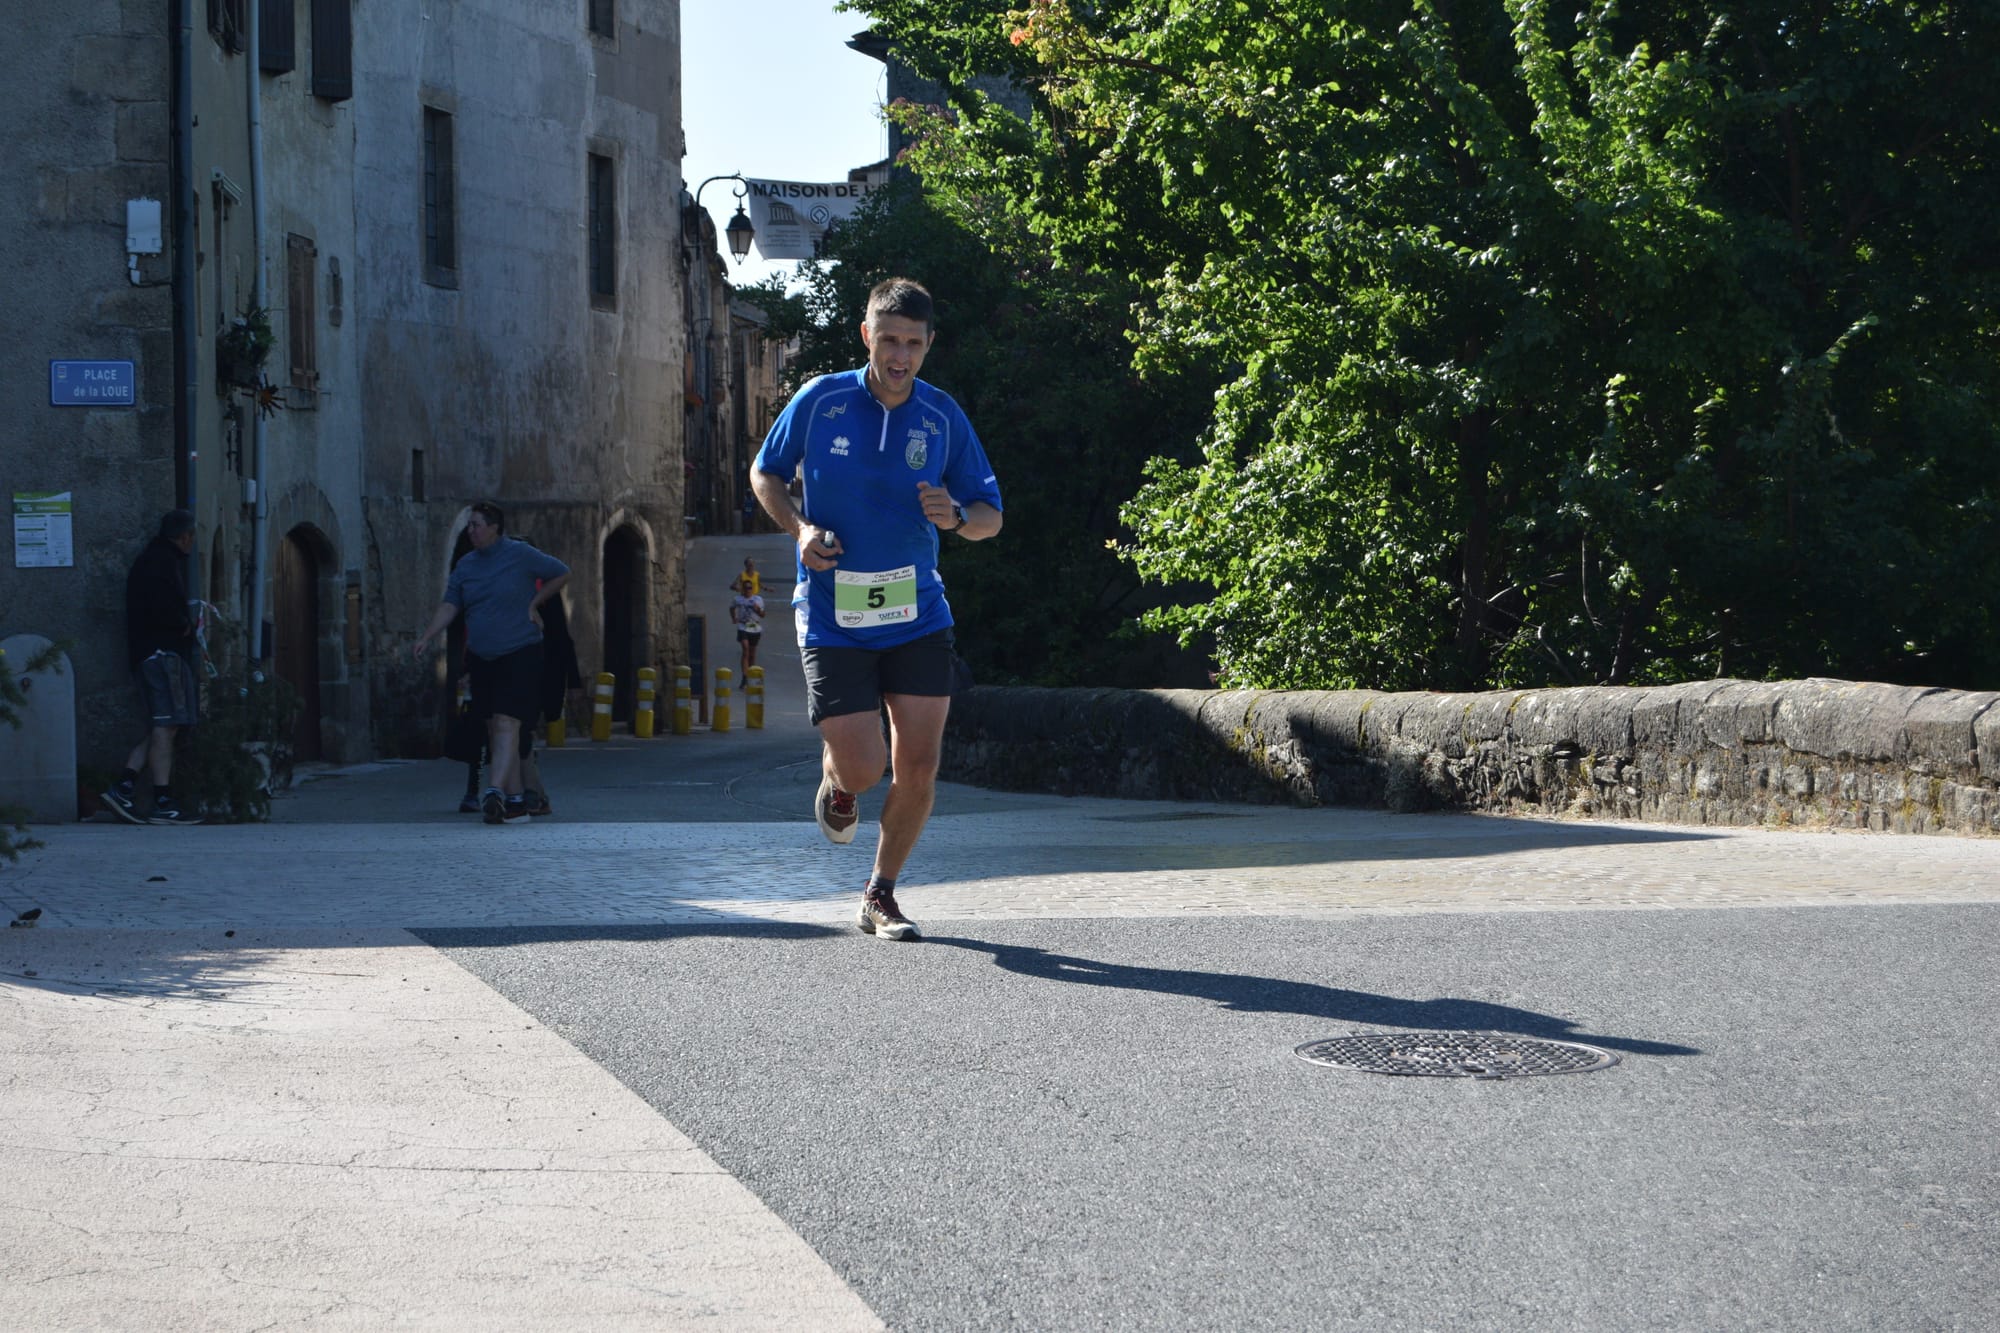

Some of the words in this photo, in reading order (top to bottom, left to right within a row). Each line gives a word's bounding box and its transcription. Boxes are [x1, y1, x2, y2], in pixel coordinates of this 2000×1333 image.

[752, 183, 830, 198] MAISON
[835, 184, 859, 197] DE
[84, 369, 117, 380] PLACE
[74, 386, 86, 397] de
[89, 386, 98, 397] la
[102, 386, 129, 397] LOUE
[867, 587, 886, 609] 5
